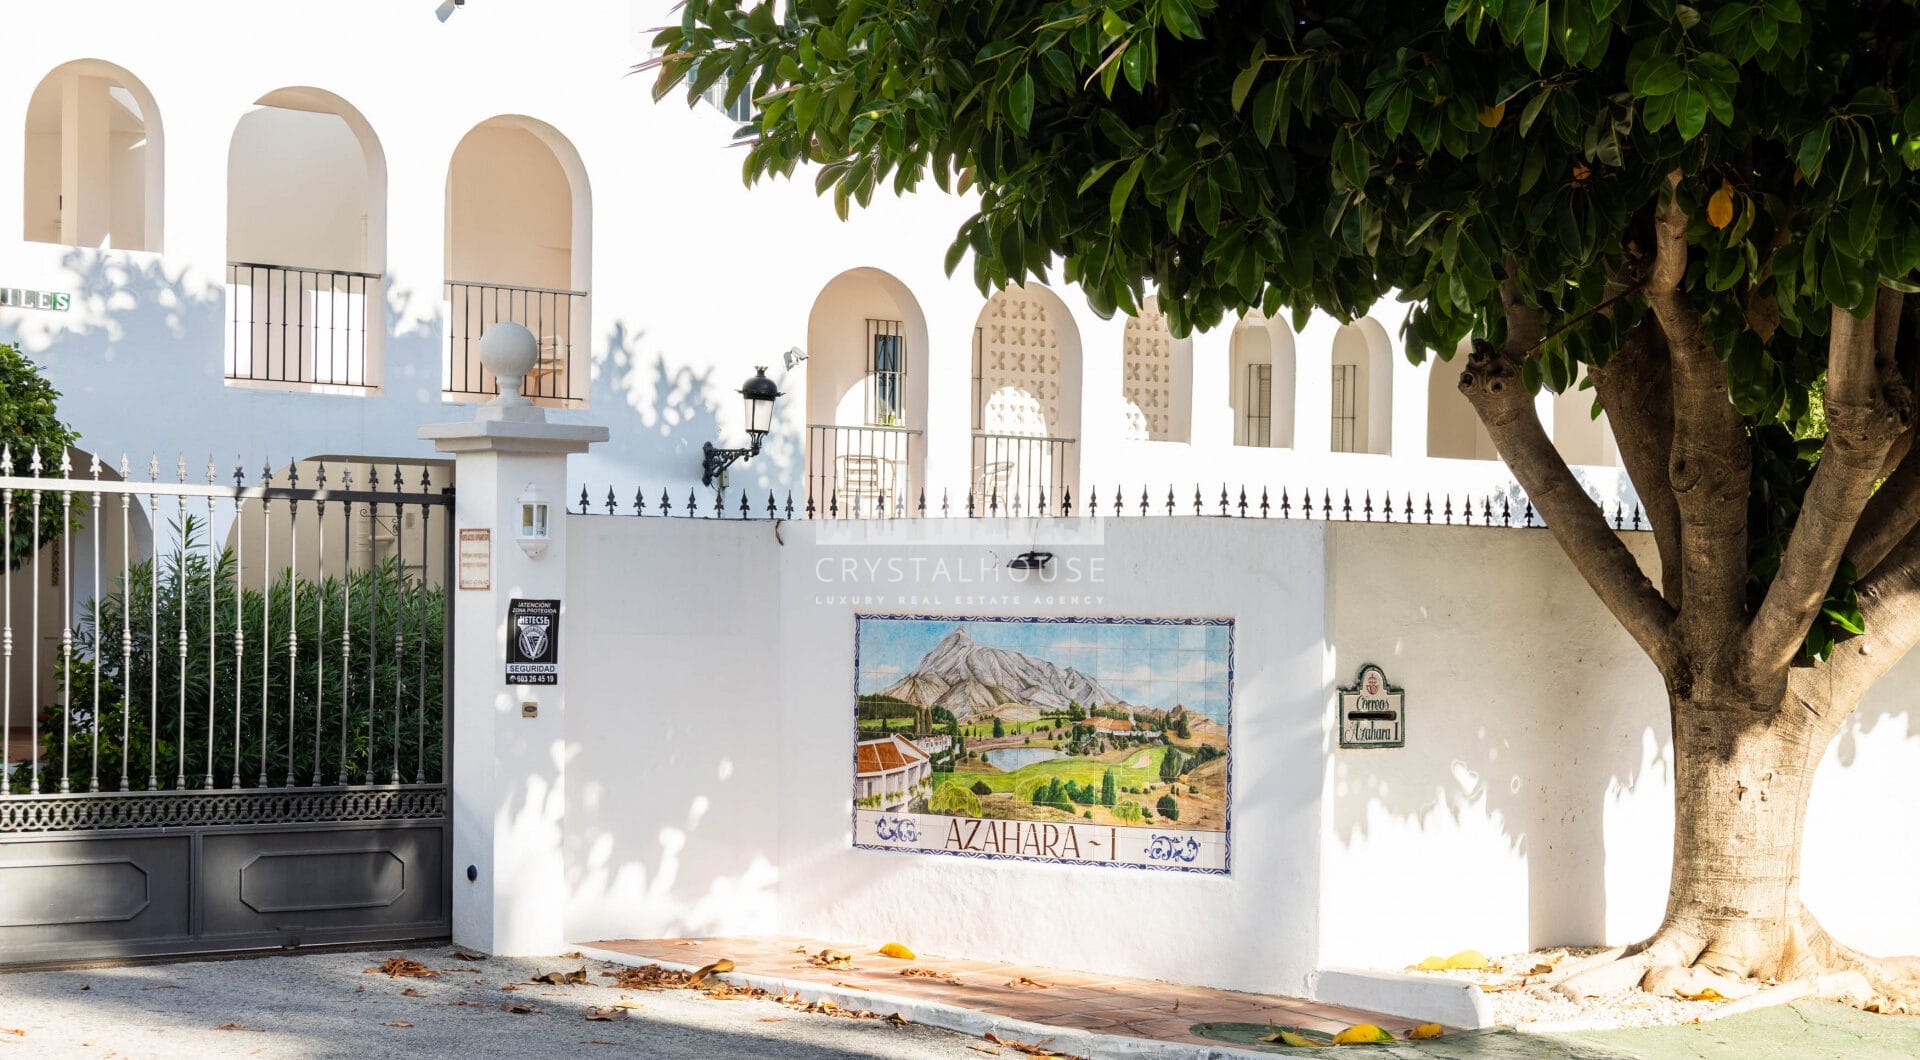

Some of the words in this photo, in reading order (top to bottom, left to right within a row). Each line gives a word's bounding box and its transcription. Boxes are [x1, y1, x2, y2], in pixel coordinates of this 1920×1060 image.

[529, 675, 536, 683] 26
[538, 675, 545, 683] 45
[1356, 695, 1390, 711] Correos
[1345, 720, 1391, 743] Azahara
[944, 818, 1080, 858] AZAHARA
